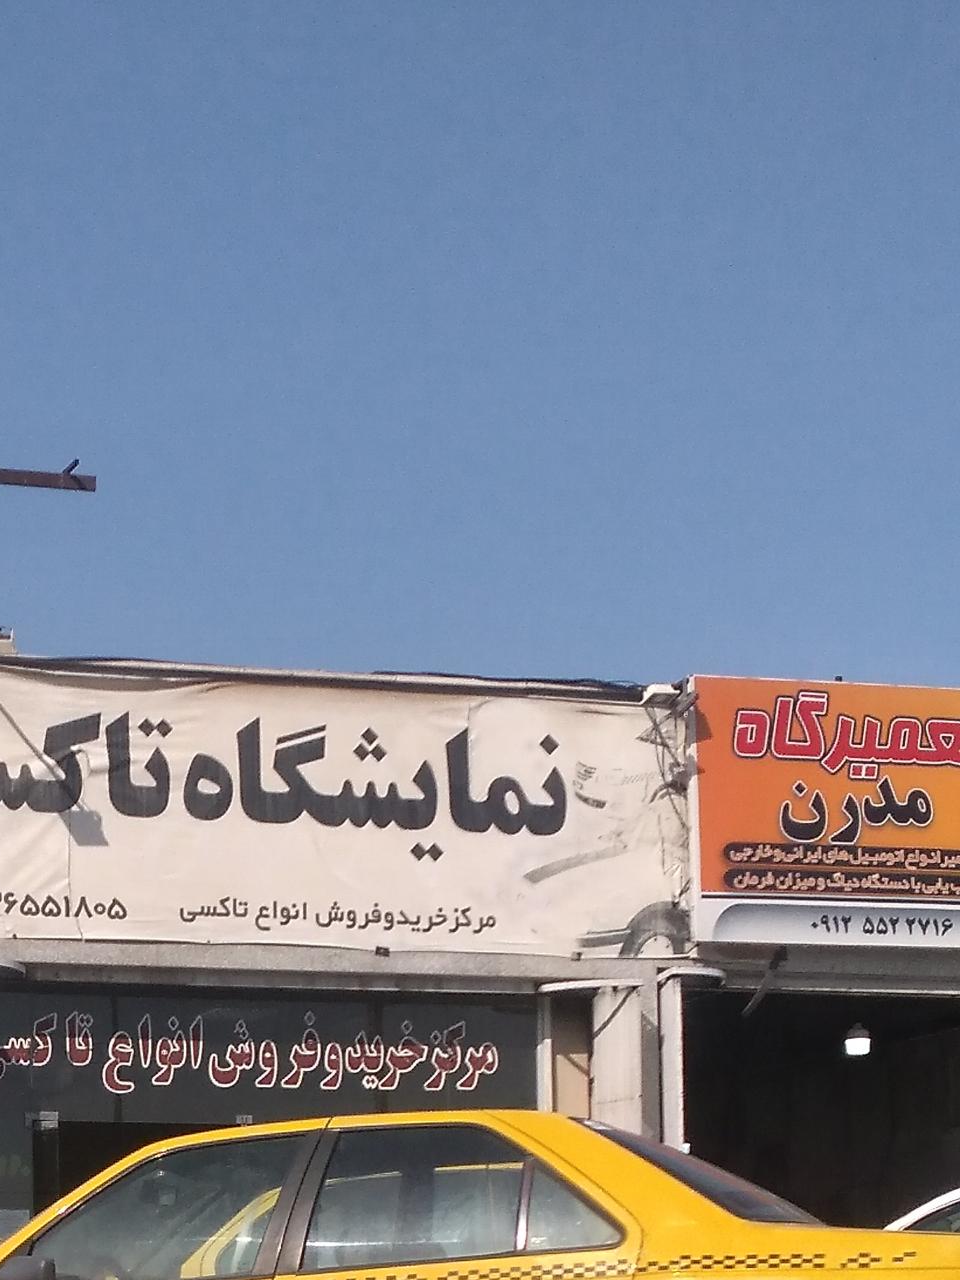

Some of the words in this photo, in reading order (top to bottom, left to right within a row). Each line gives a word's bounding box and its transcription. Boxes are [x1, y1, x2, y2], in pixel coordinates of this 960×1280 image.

[734, 691, 960, 778] عمیرگاه
[183, 717, 568, 862] نمایشگاه
[780, 777, 933, 845] مدرن
[906, 849, 940, 870] انواع
[179, 896, 249, 923] تاکسی
[254, 900, 308, 931] انواع
[102, 1012, 204, 1094] انواع
